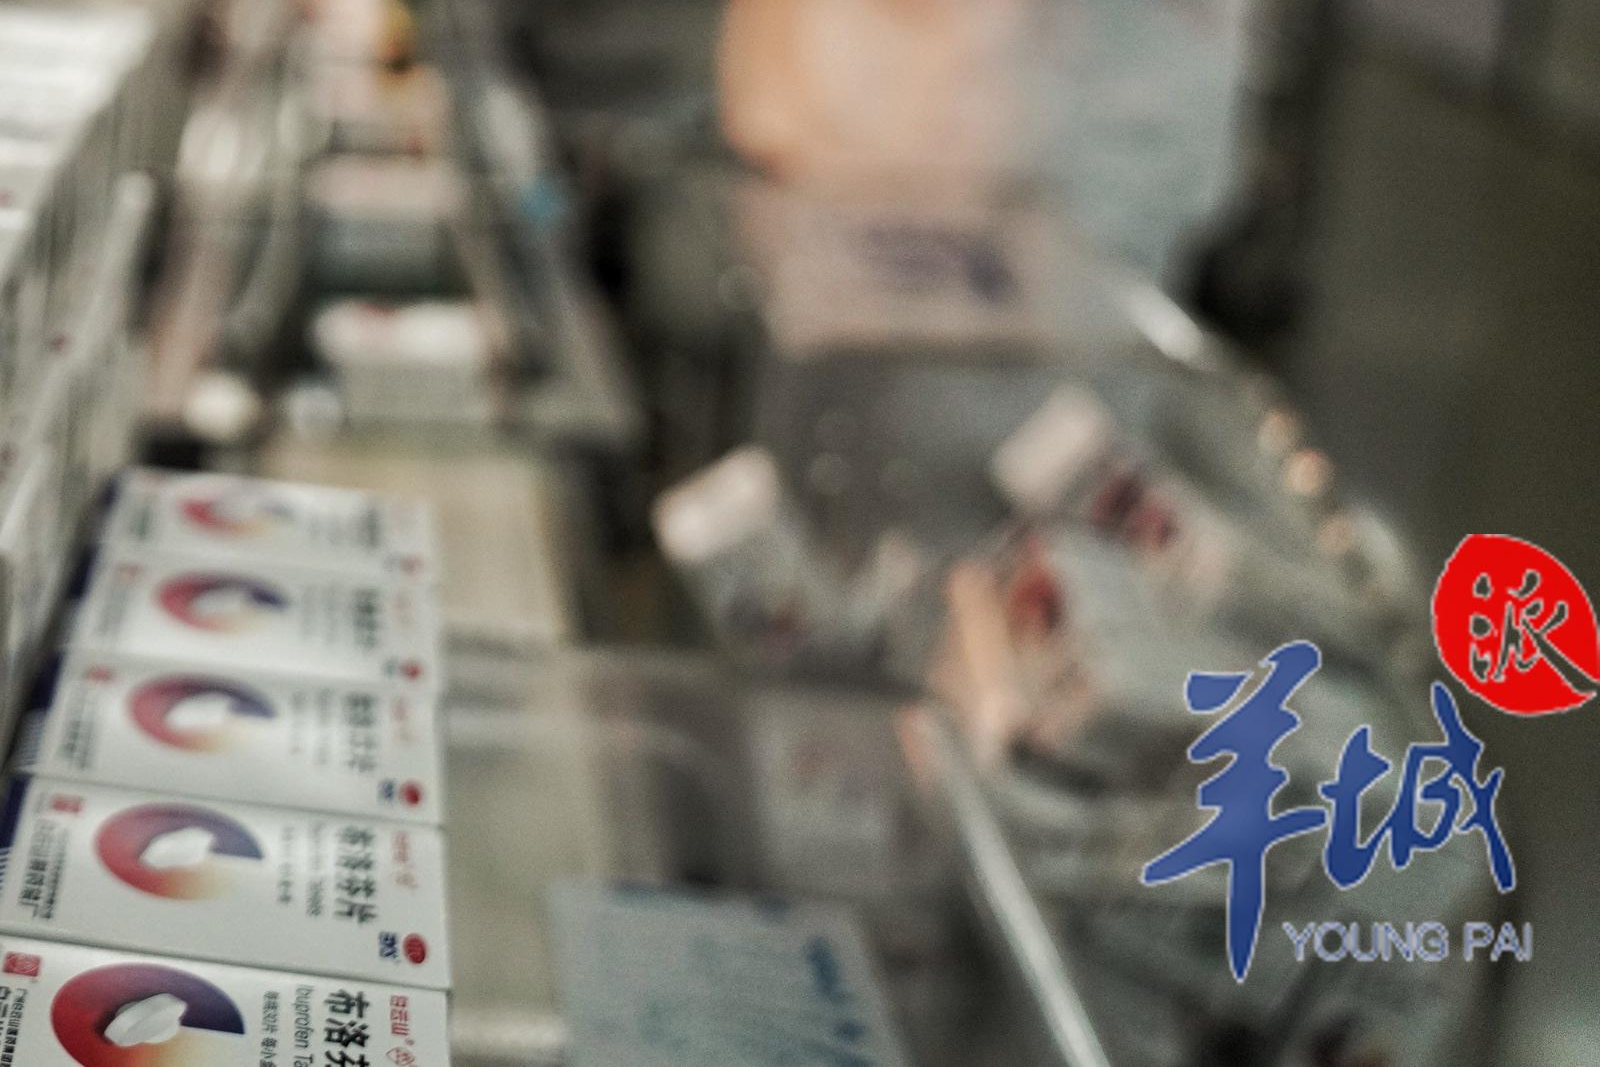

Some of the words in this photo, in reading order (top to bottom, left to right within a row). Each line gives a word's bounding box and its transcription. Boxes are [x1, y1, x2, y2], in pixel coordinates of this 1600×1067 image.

[291, 984, 314, 1049] Ibuprofen
[390, 995, 409, 1036] 白云山
